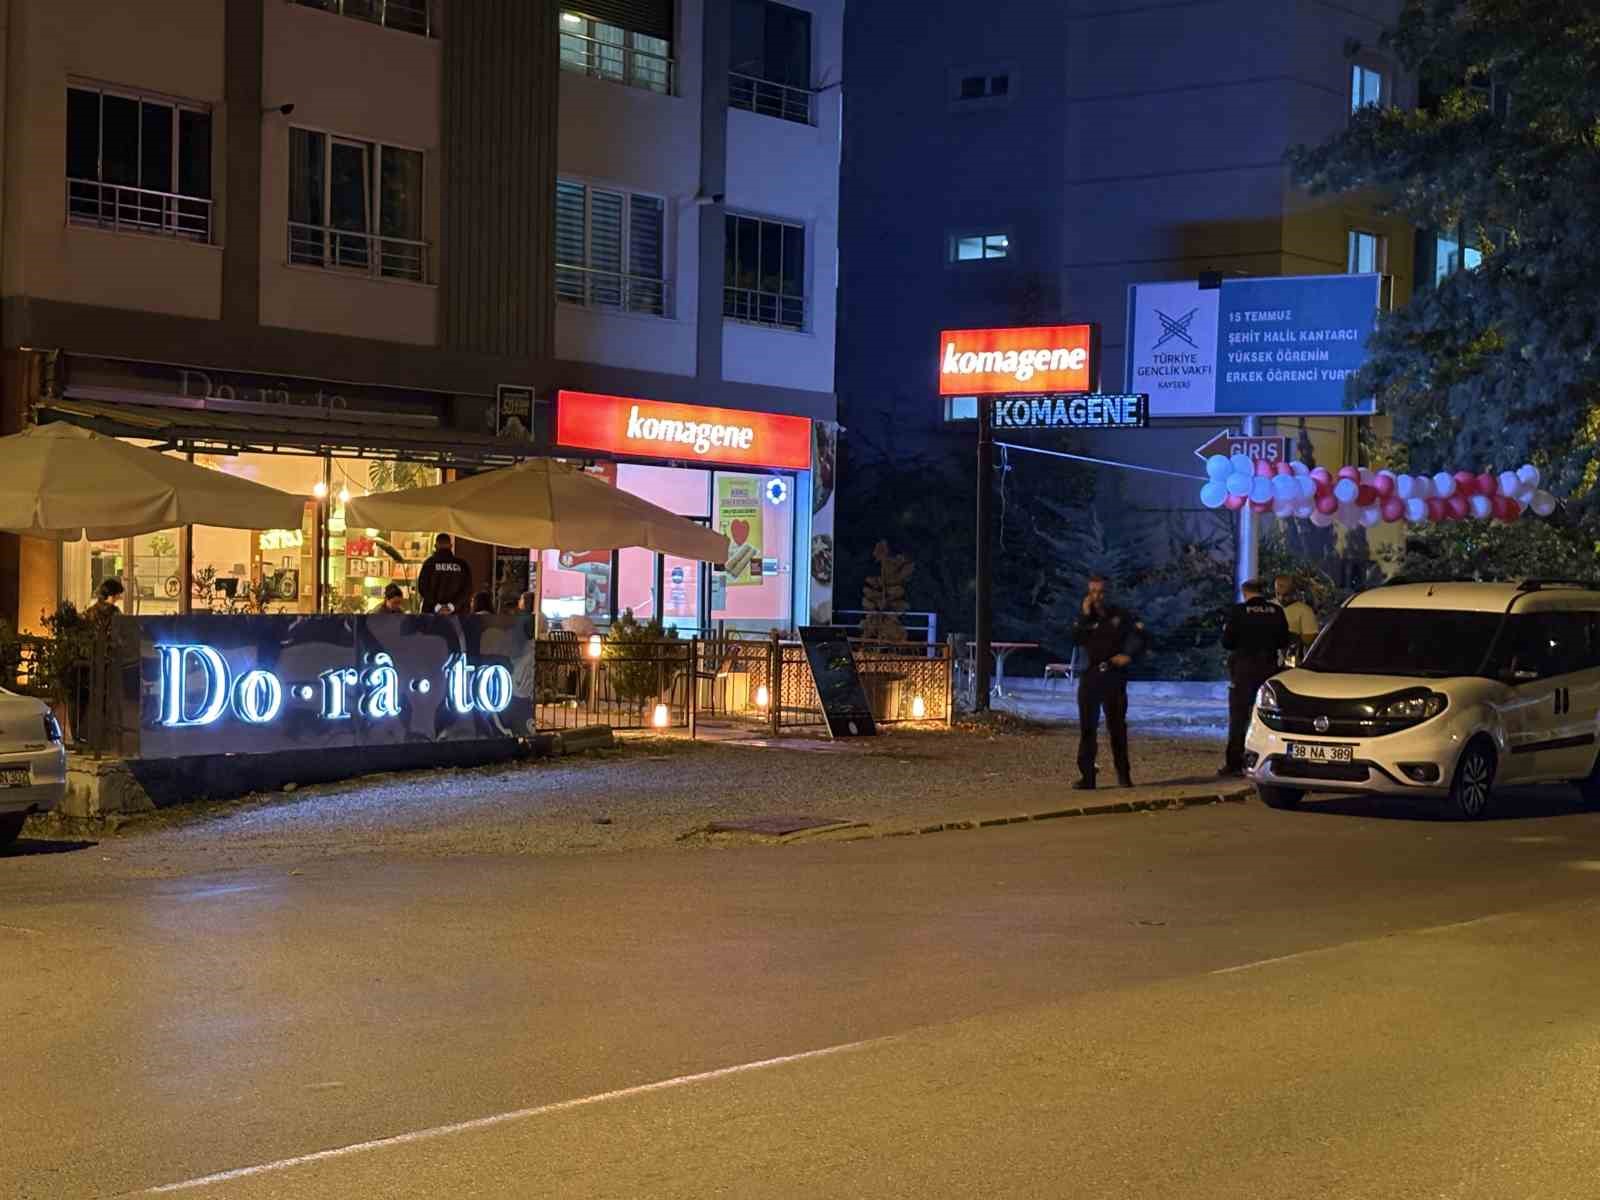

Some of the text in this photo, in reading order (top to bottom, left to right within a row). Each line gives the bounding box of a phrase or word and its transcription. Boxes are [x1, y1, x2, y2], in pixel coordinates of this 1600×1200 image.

[1229, 310, 1292, 321] 15 TEMMUZ
[1300, 329, 1358, 341] KANTARCI
[942, 343, 1087, 382] komagene
[1228, 350, 1273, 362] YÜKSEK
[1226, 371, 1263, 383] ERKEK
[995, 397, 1138, 426] KOMAGENE
[626, 405, 754, 454] komagene
[1294, 745, 1352, 760] 38 NA 389
